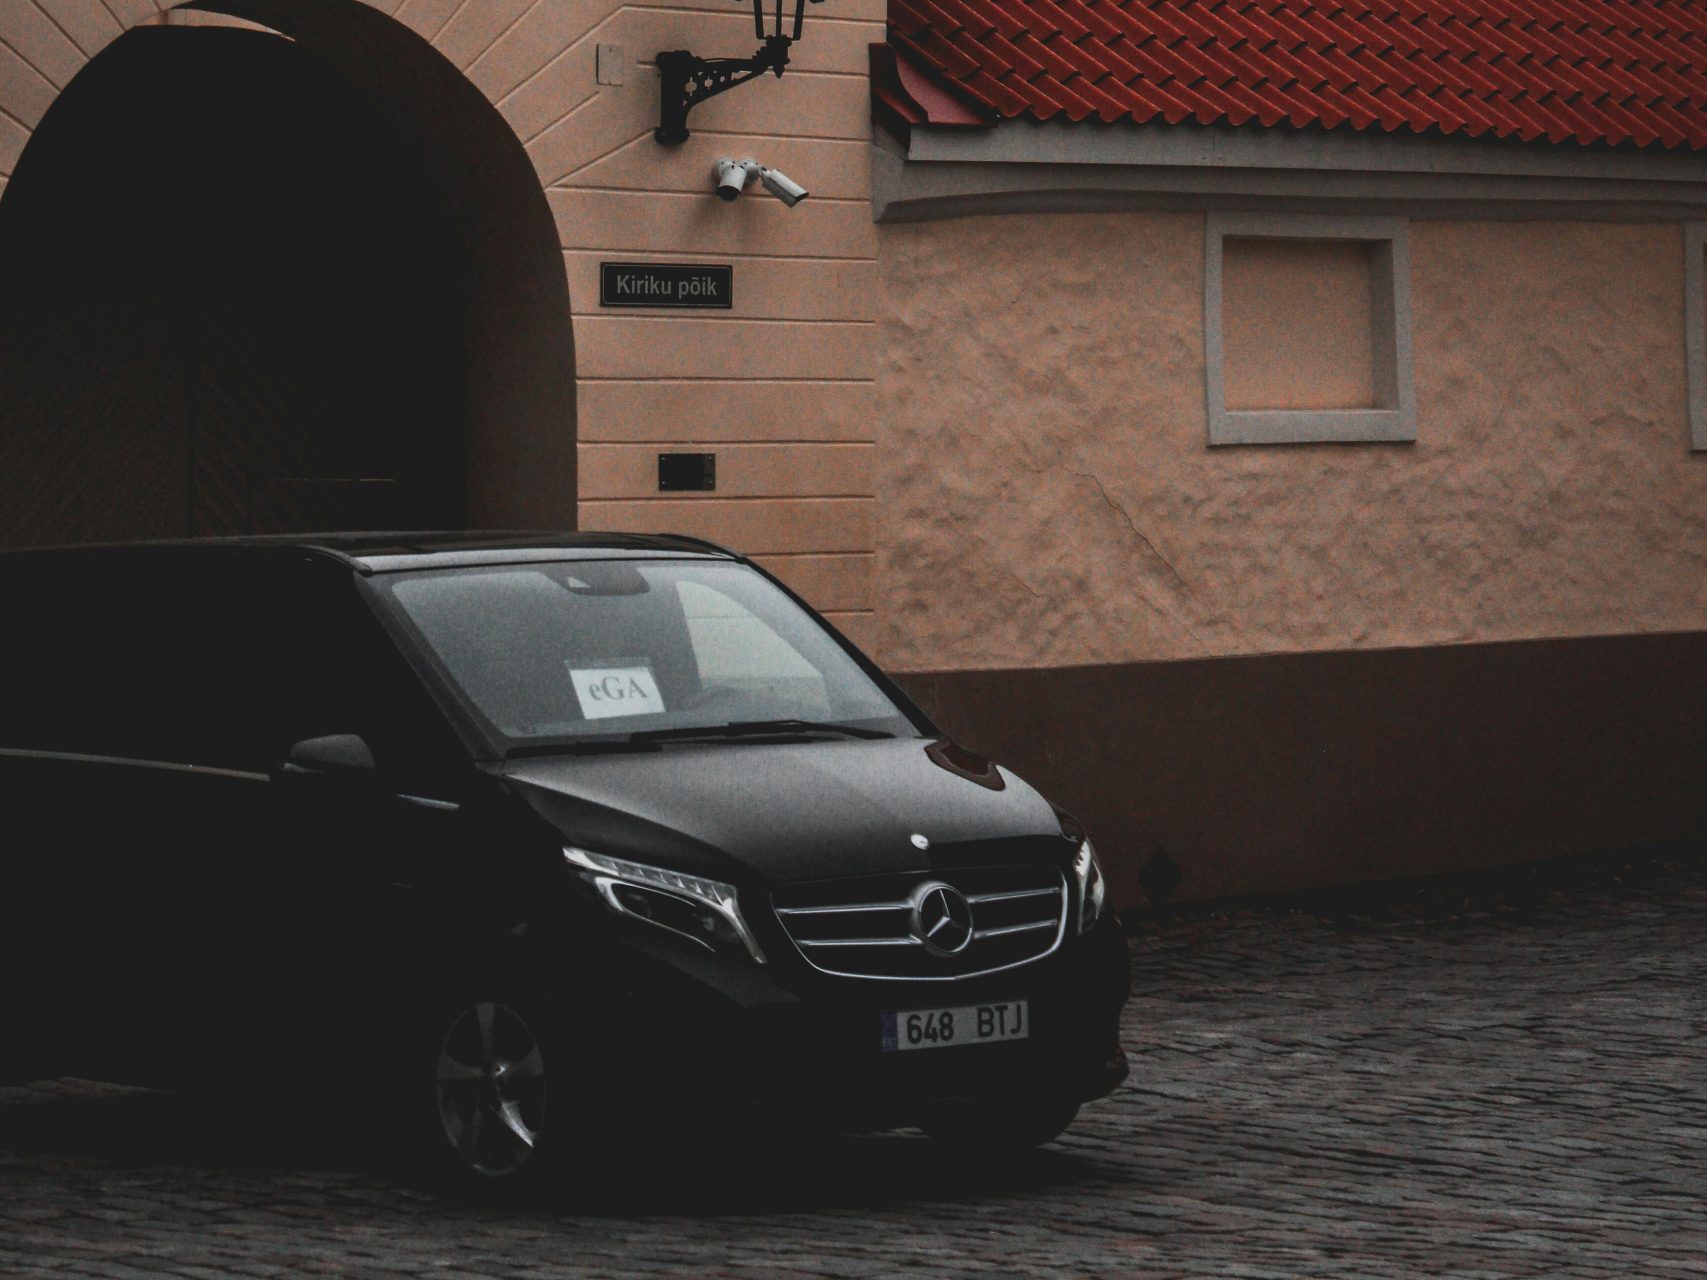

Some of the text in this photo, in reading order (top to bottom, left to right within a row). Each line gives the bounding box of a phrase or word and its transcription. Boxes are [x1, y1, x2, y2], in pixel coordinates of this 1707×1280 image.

[617, 275, 718, 300] Kiriku põik
[588, 676, 648, 701] eGA
[906, 1003, 1022, 1044] 648 BTJ
